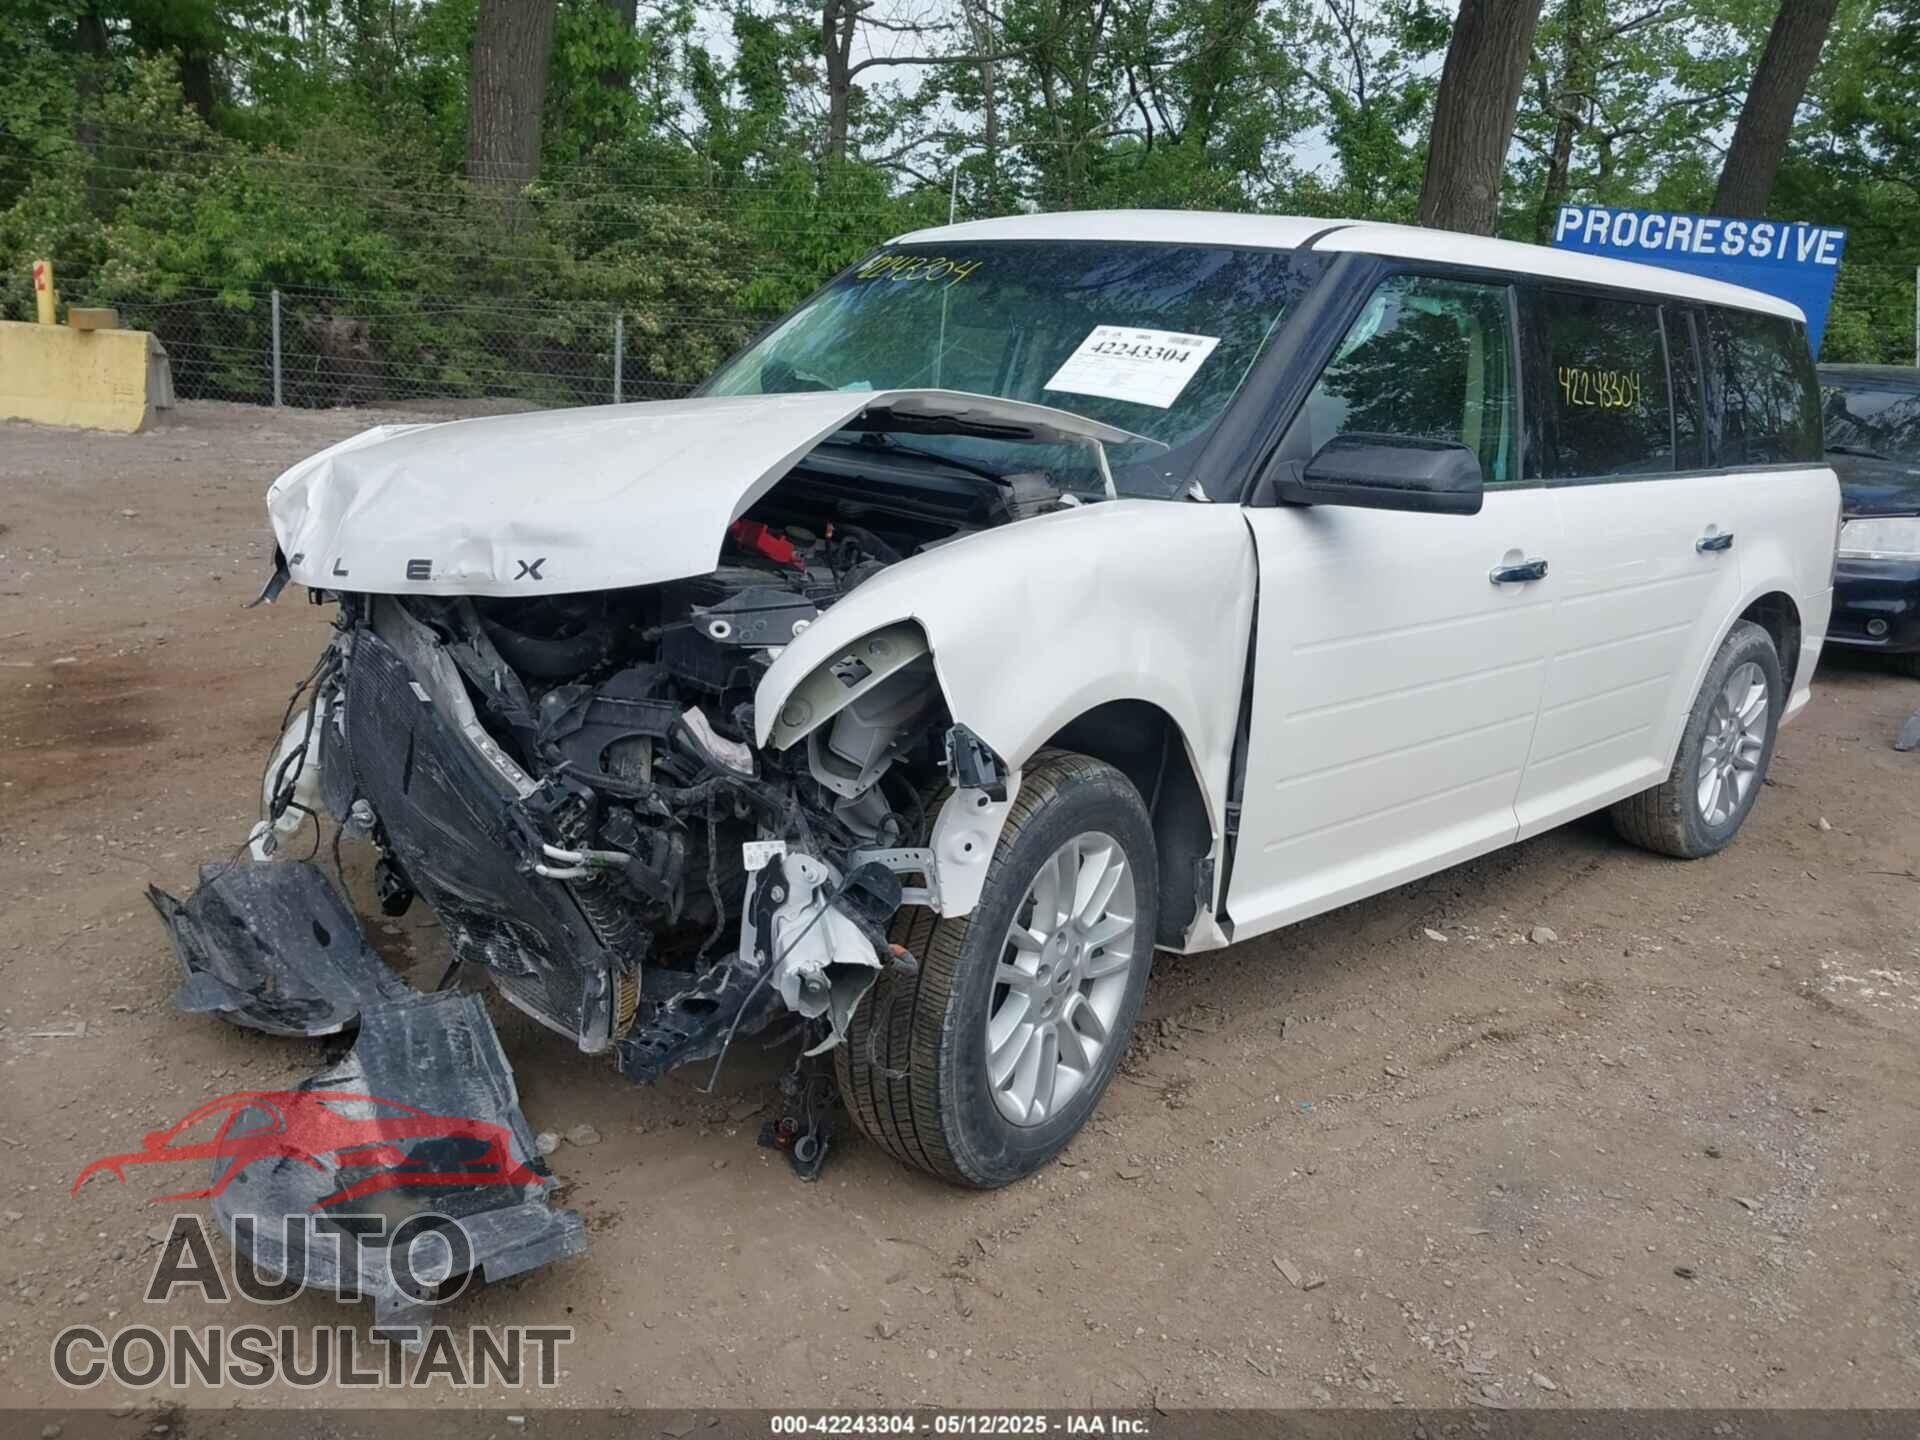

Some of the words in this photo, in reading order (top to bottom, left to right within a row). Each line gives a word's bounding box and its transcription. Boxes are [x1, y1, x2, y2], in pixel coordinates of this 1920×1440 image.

[1556, 207, 1845, 265] PROGRESSIVE
[1090, 341, 1191, 363] 42243304
[1558, 366, 1640, 408] 42243304
